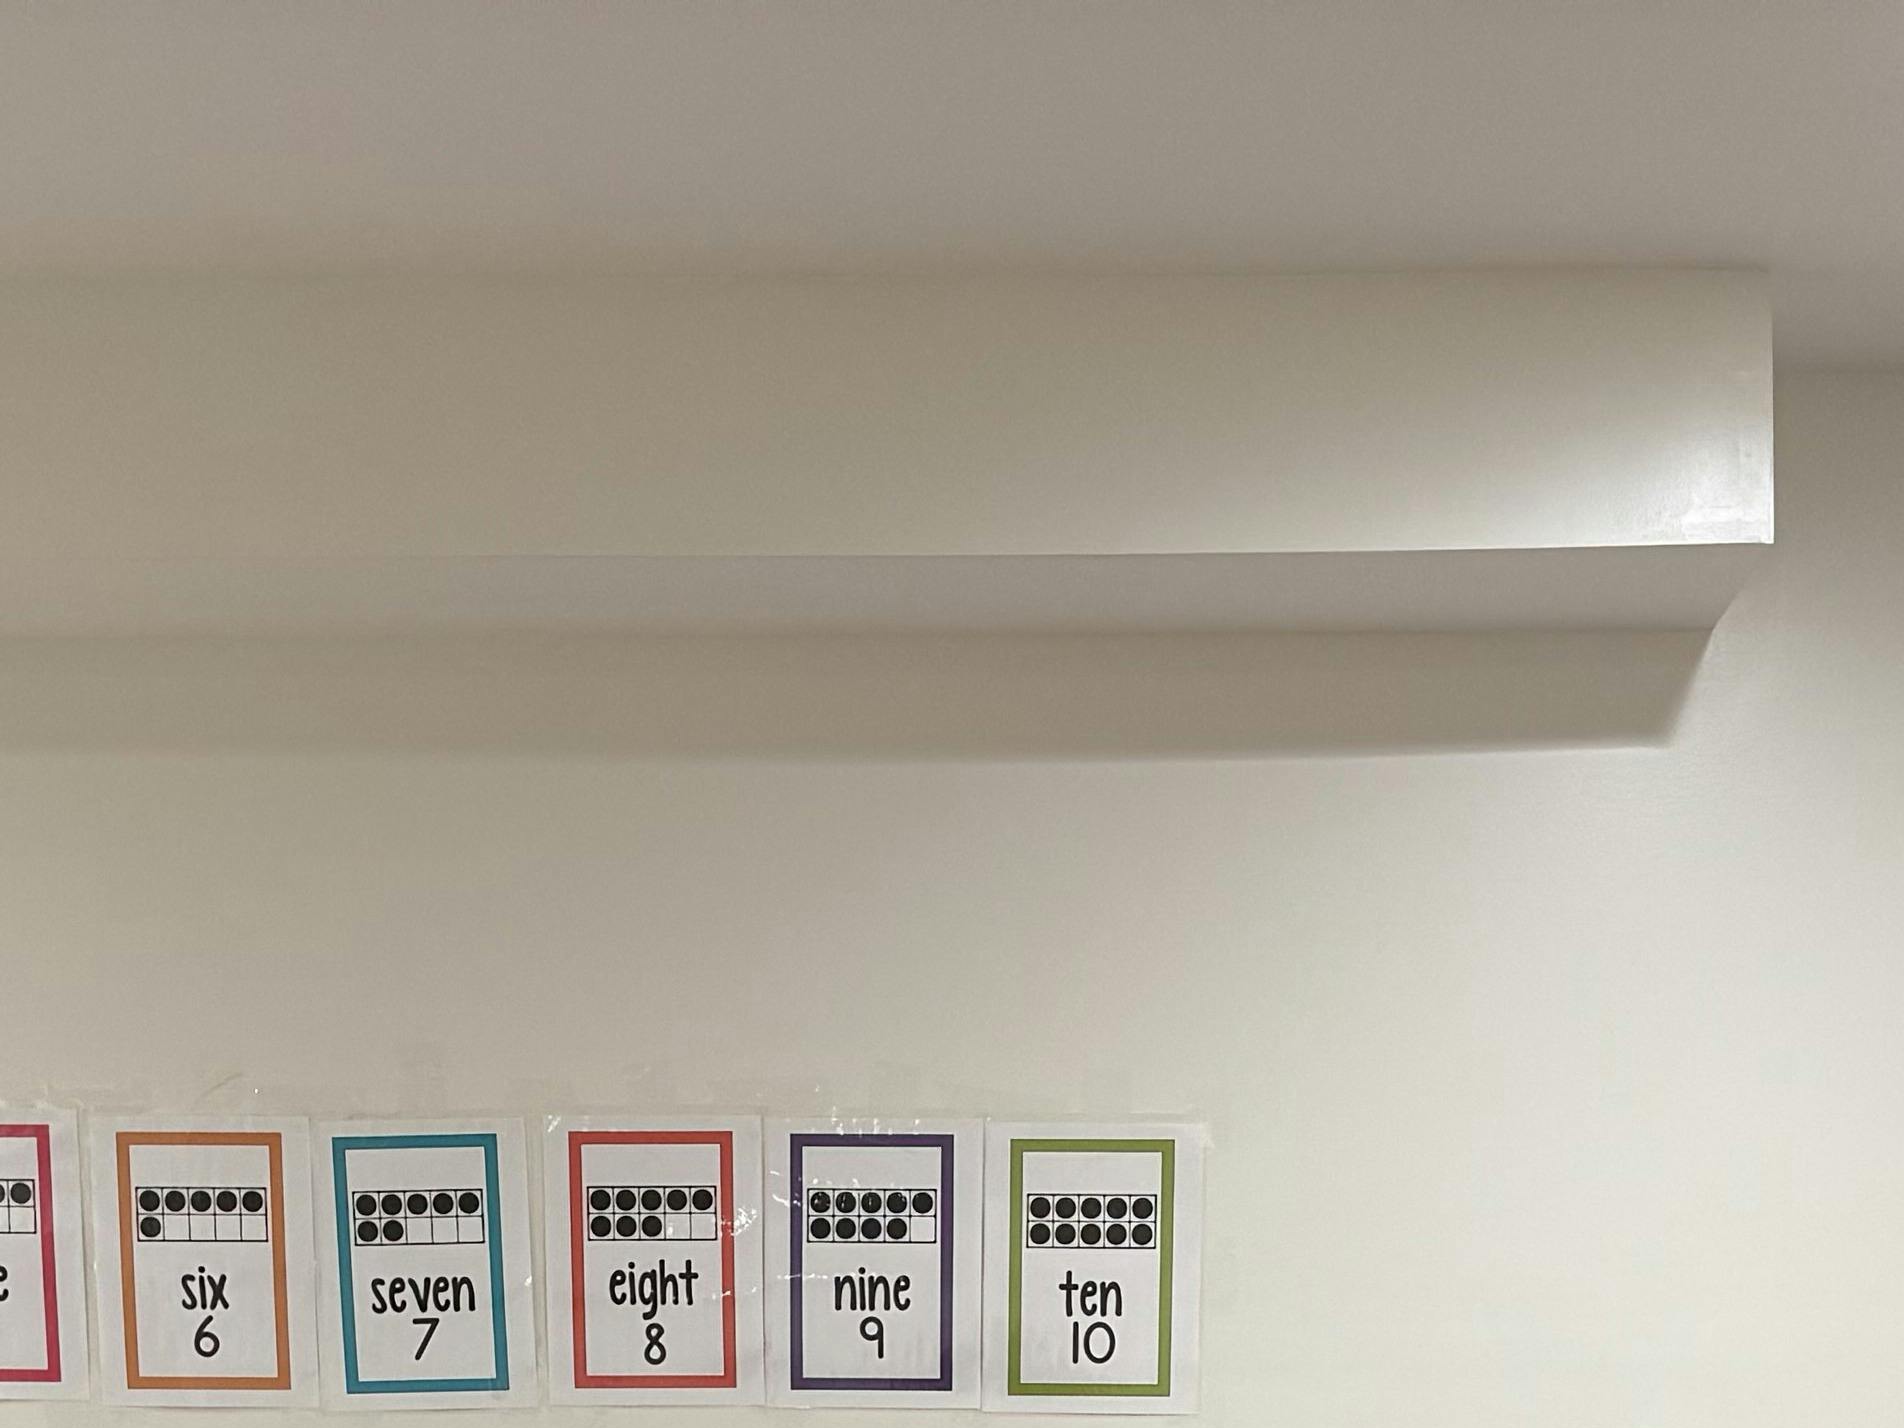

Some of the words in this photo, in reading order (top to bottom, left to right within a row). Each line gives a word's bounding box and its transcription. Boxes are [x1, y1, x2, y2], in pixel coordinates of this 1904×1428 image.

[181, 1265, 230, 1311] six
[370, 1276, 476, 1315] seven
[609, 1258, 699, 1321] eight
[834, 1266, 911, 1312] nine
[1058, 1270, 1123, 1318] ten
[193, 1314, 220, 1358] 6
[412, 1317, 440, 1361] 7
[643, 1322, 667, 1366] 8
[859, 1316, 884, 1360] 9
[1072, 1321, 1116, 1365] 10
